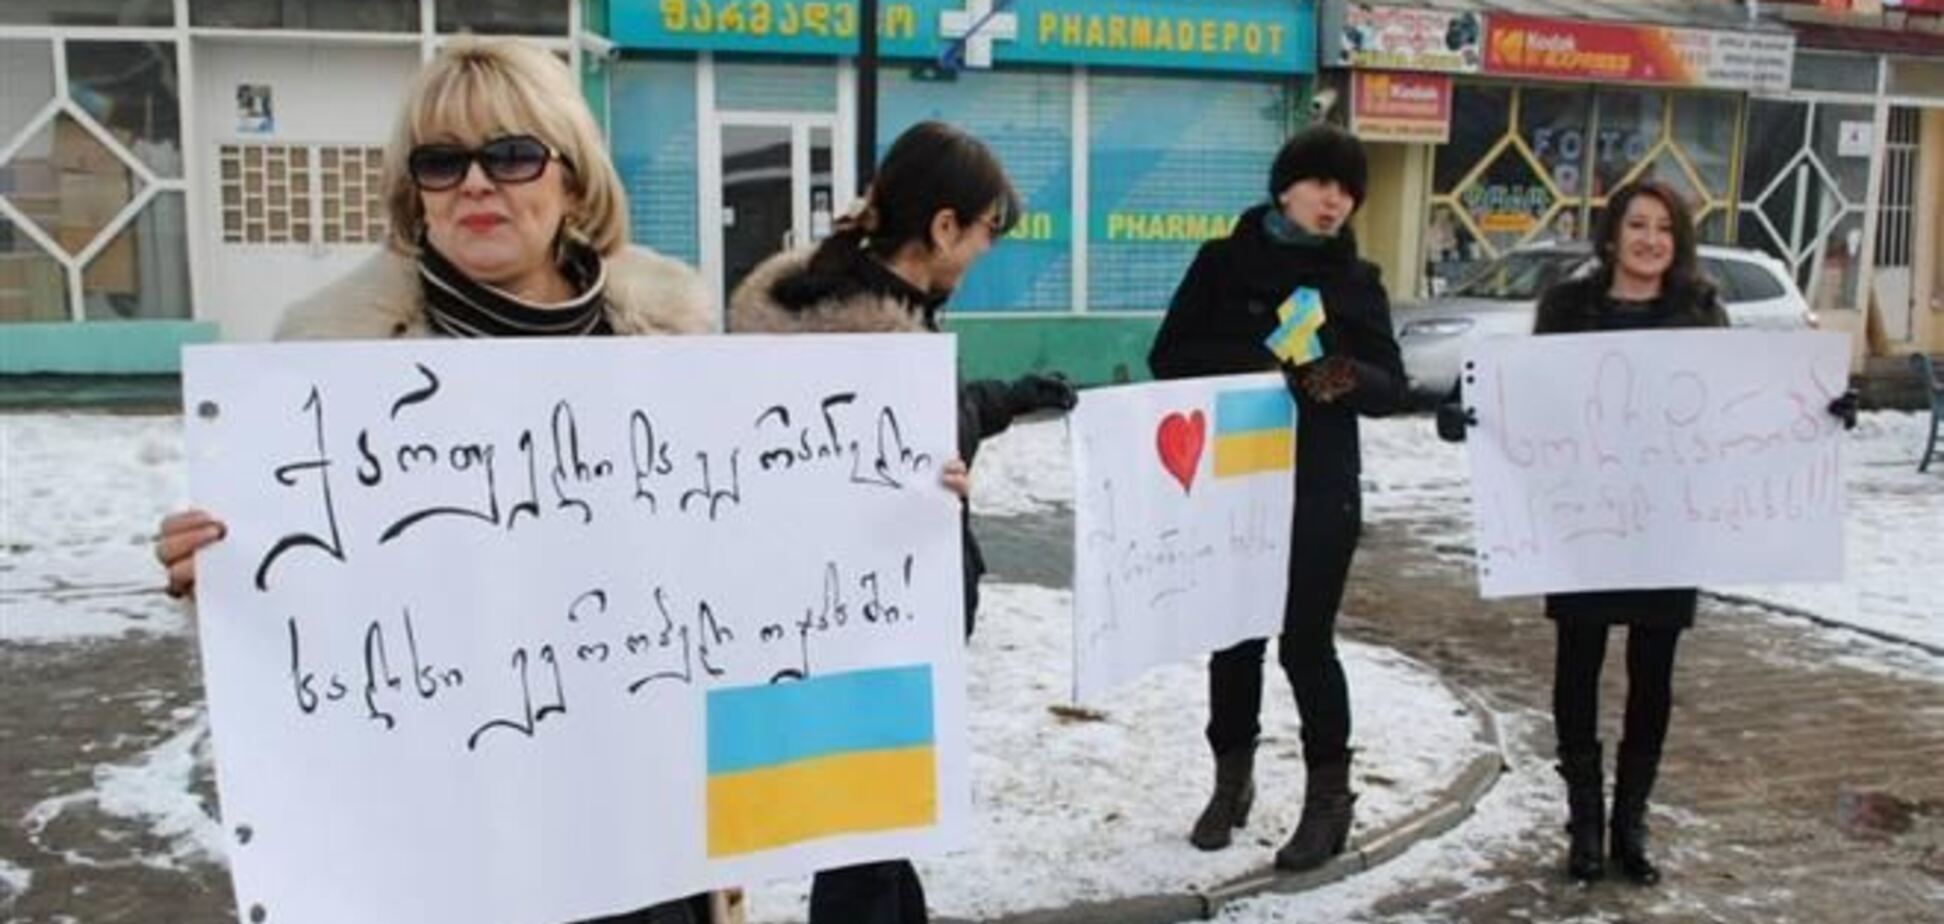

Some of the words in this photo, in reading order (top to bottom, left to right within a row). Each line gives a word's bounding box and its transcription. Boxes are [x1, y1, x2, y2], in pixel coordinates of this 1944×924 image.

[660, 0, 915, 39] ფარმადეო
[1038, 11, 1285, 56] PHARMADEPOT
[1533, 127, 1645, 162] FOTO
[629, 408, 673, 515] და
